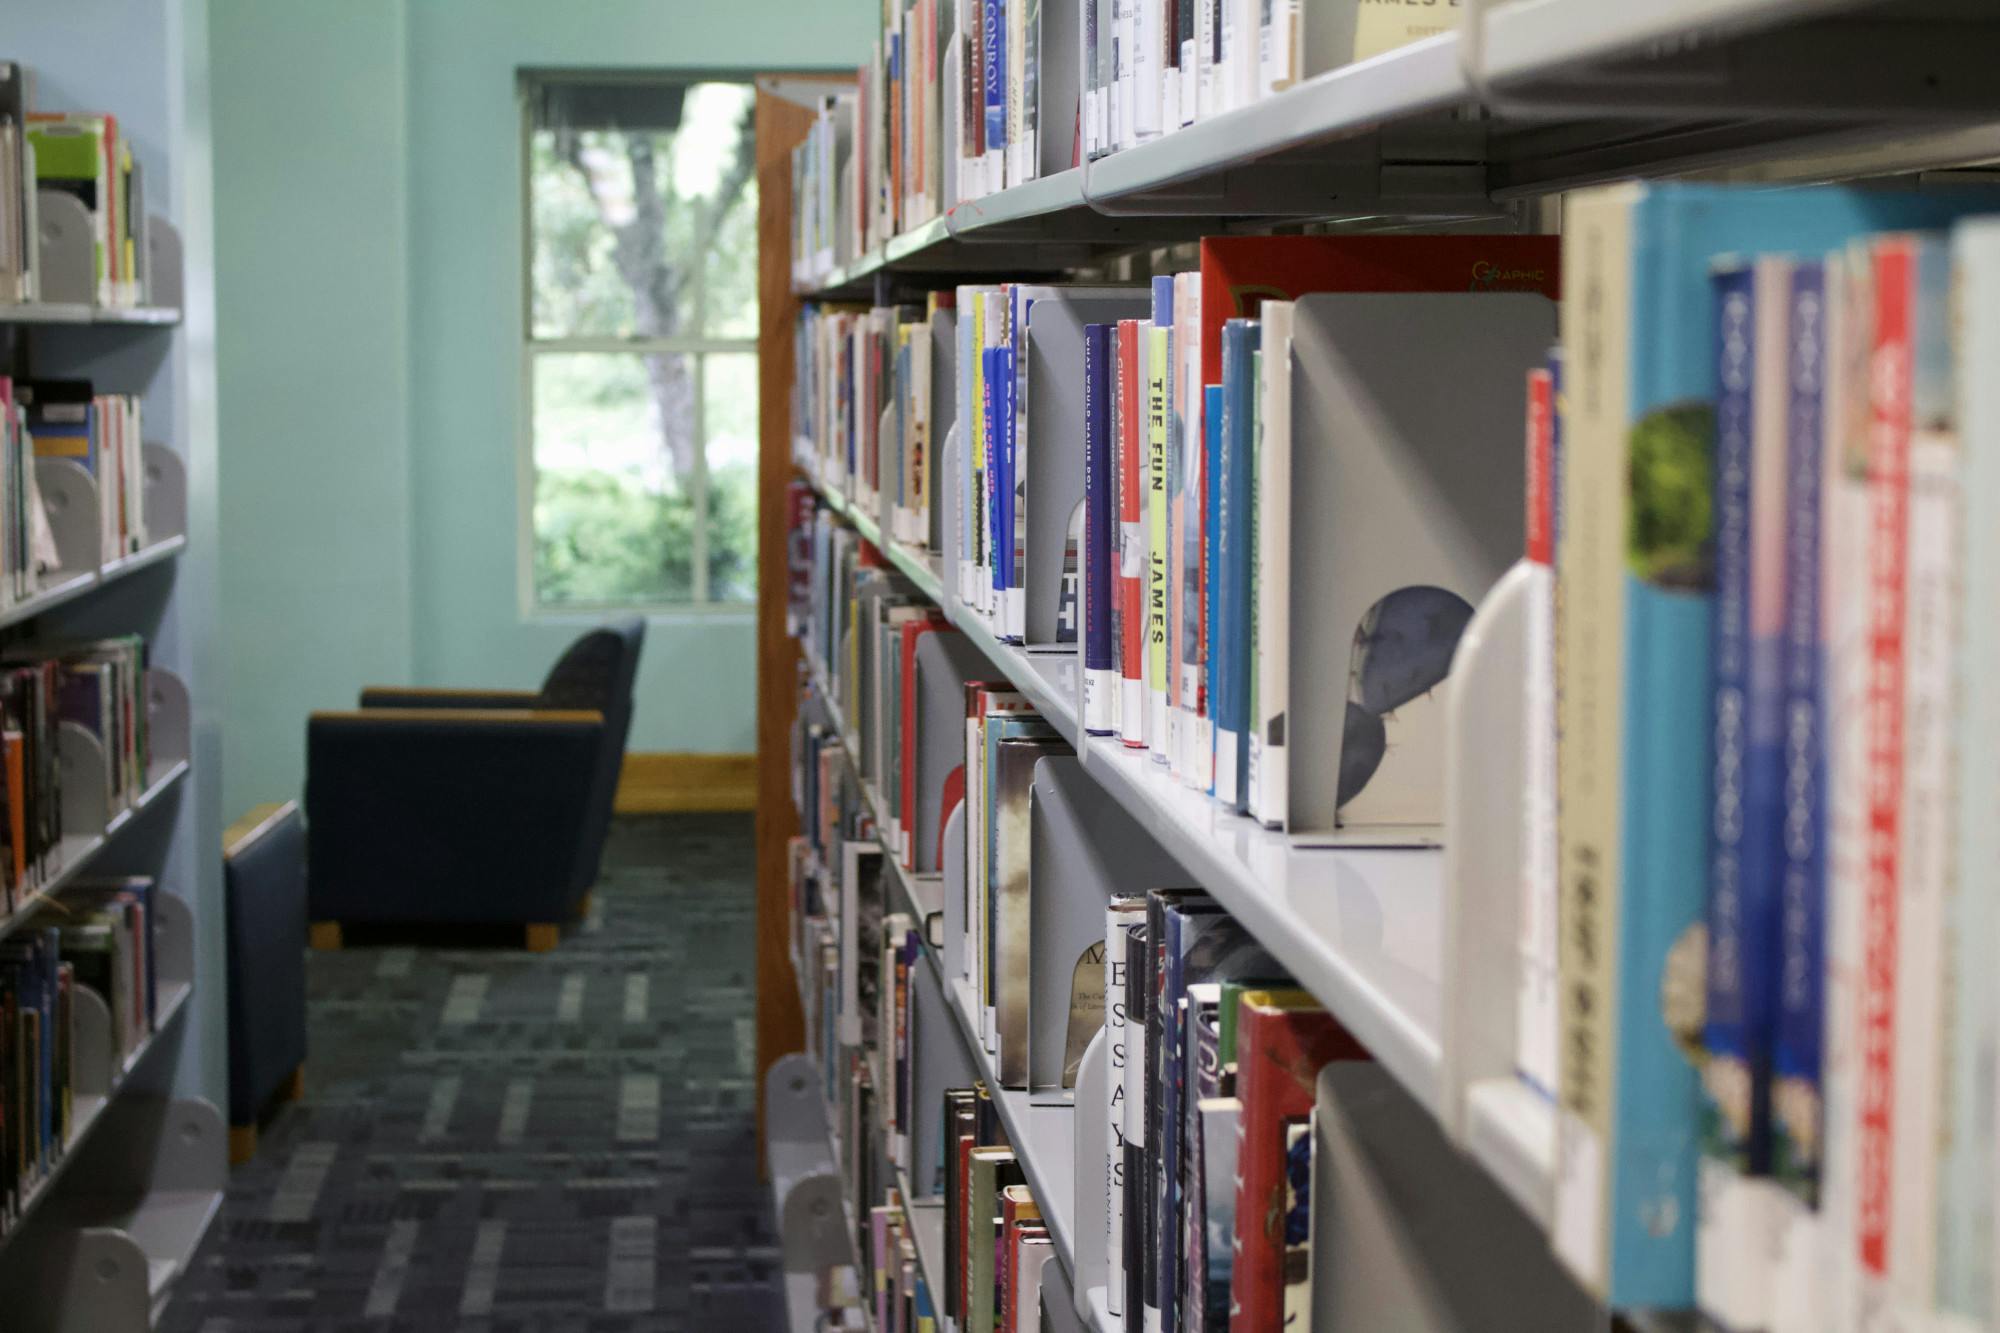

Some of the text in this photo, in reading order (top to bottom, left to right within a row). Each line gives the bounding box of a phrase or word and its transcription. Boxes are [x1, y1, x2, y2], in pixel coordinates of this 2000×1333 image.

[986, 2, 997, 95] CONROY
[1118, 409, 1125, 429] AT
[1151, 377, 1164, 491] THE FUN
[1151, 551, 1166, 645] JAMES
[1111, 961, 1126, 1188] ESSAYS
[1104, 1153, 1112, 1236] EMMANUEL
